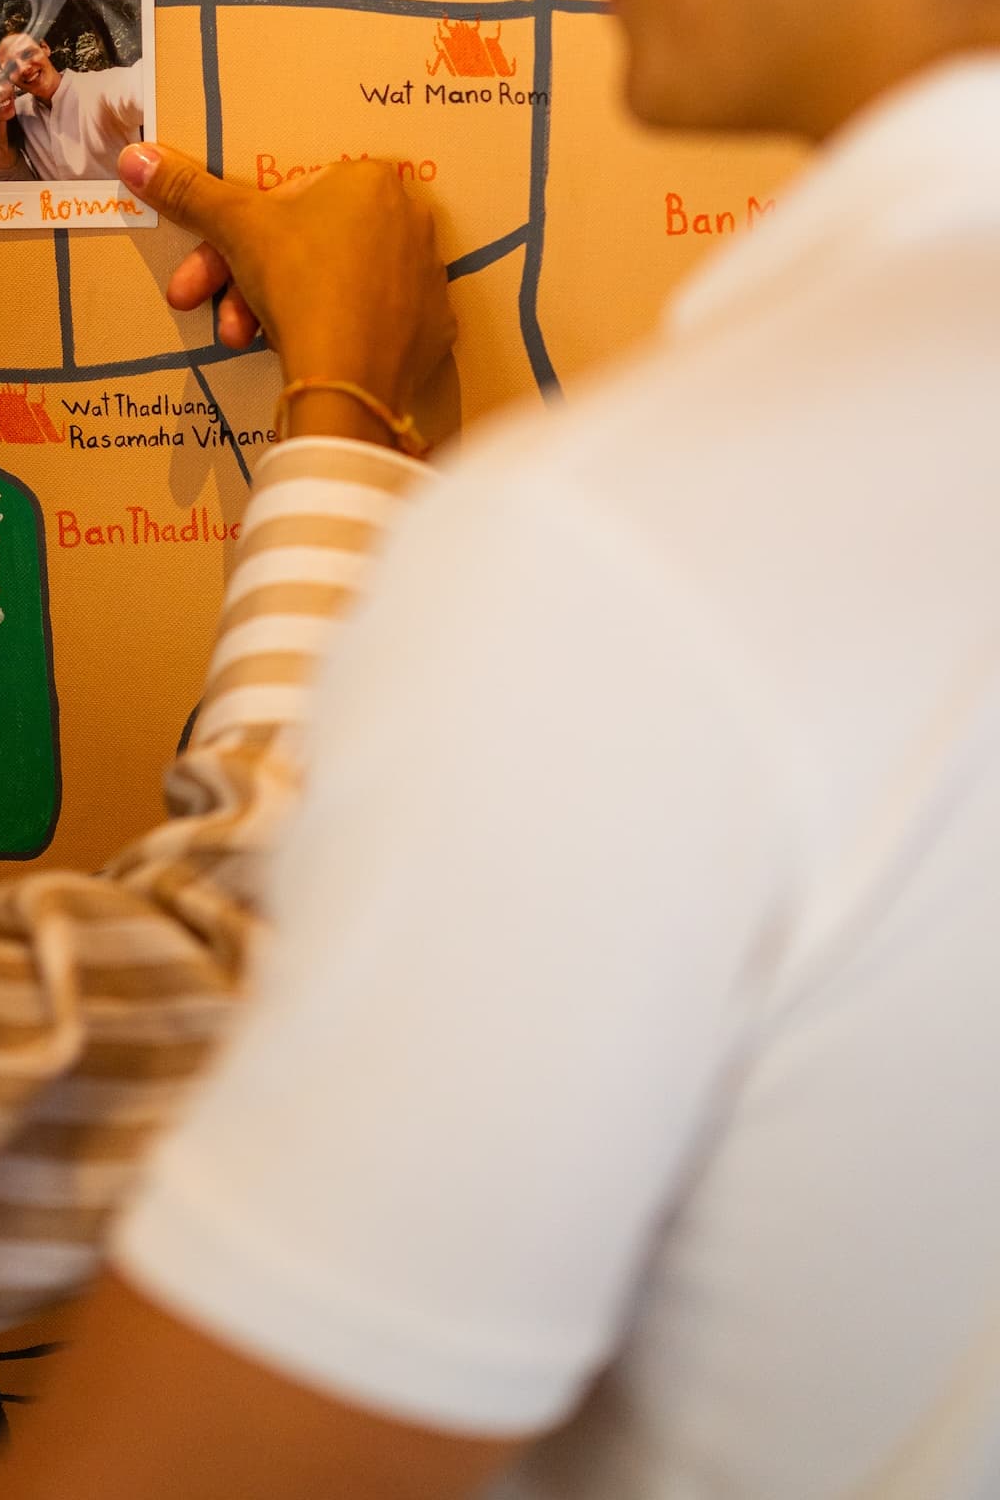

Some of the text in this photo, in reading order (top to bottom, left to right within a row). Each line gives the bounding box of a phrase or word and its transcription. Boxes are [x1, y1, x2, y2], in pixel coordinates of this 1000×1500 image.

[360, 80, 552, 106] Wat Mano Rom
[664, 191, 735, 237] Ban
[61, 392, 220, 424] Wat Thadluang
[69, 420, 278, 450] Rasamaha Vihane
[56, 509, 126, 549] Ban
